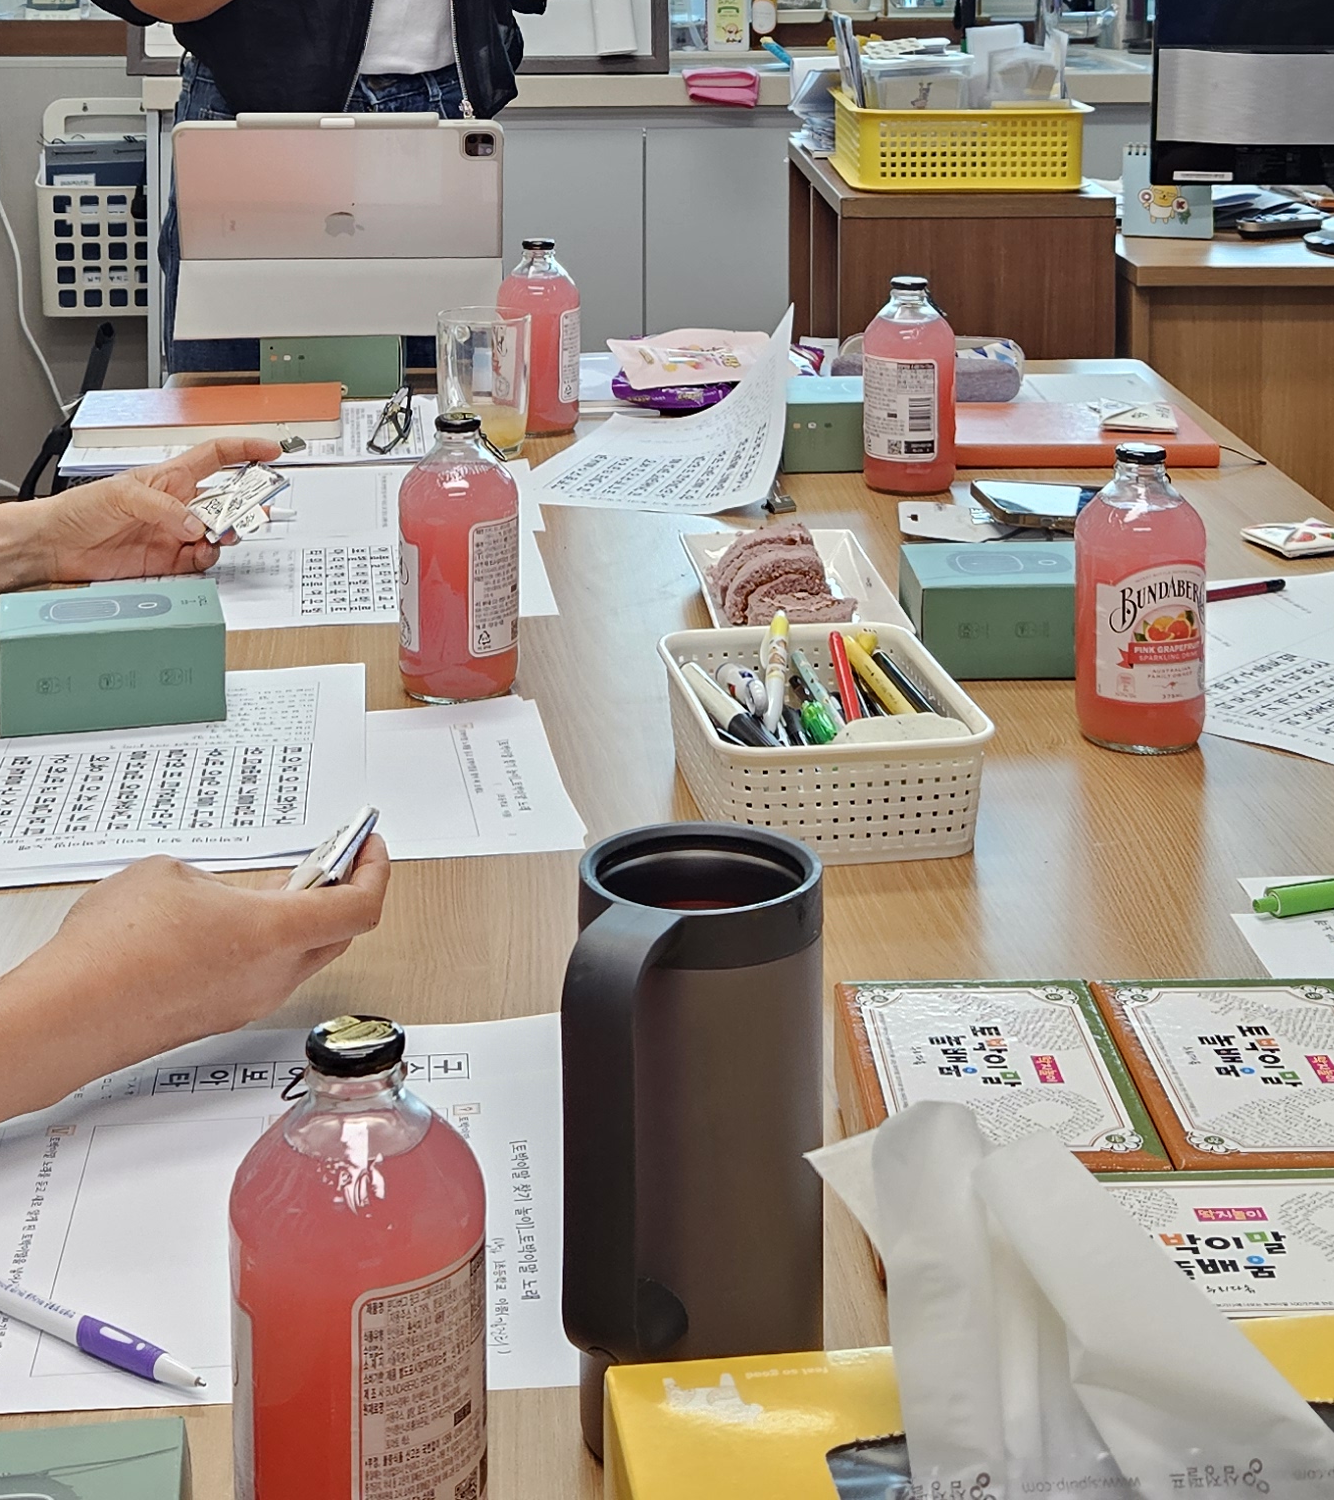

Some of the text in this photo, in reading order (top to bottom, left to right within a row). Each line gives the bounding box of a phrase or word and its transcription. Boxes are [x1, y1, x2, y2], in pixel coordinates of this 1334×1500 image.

[1134, 646, 1155, 654] PINK
[929, 1035, 979, 1078] 놀배움
[971, 1025, 1023, 1086] 토박이말
[1198, 1035, 1255, 1078] 놀배움
[1237, 1025, 1304, 1088] 토박이말
[509, 1139, 529, 1179] [토박이말
[512, 1183, 533, 1202] 찾기
[1196, 1208, 1264, 1221] 딱지놀이
[1158, 1230, 1293, 1257] 박이말
[520, 1279, 540, 1300] 노래
